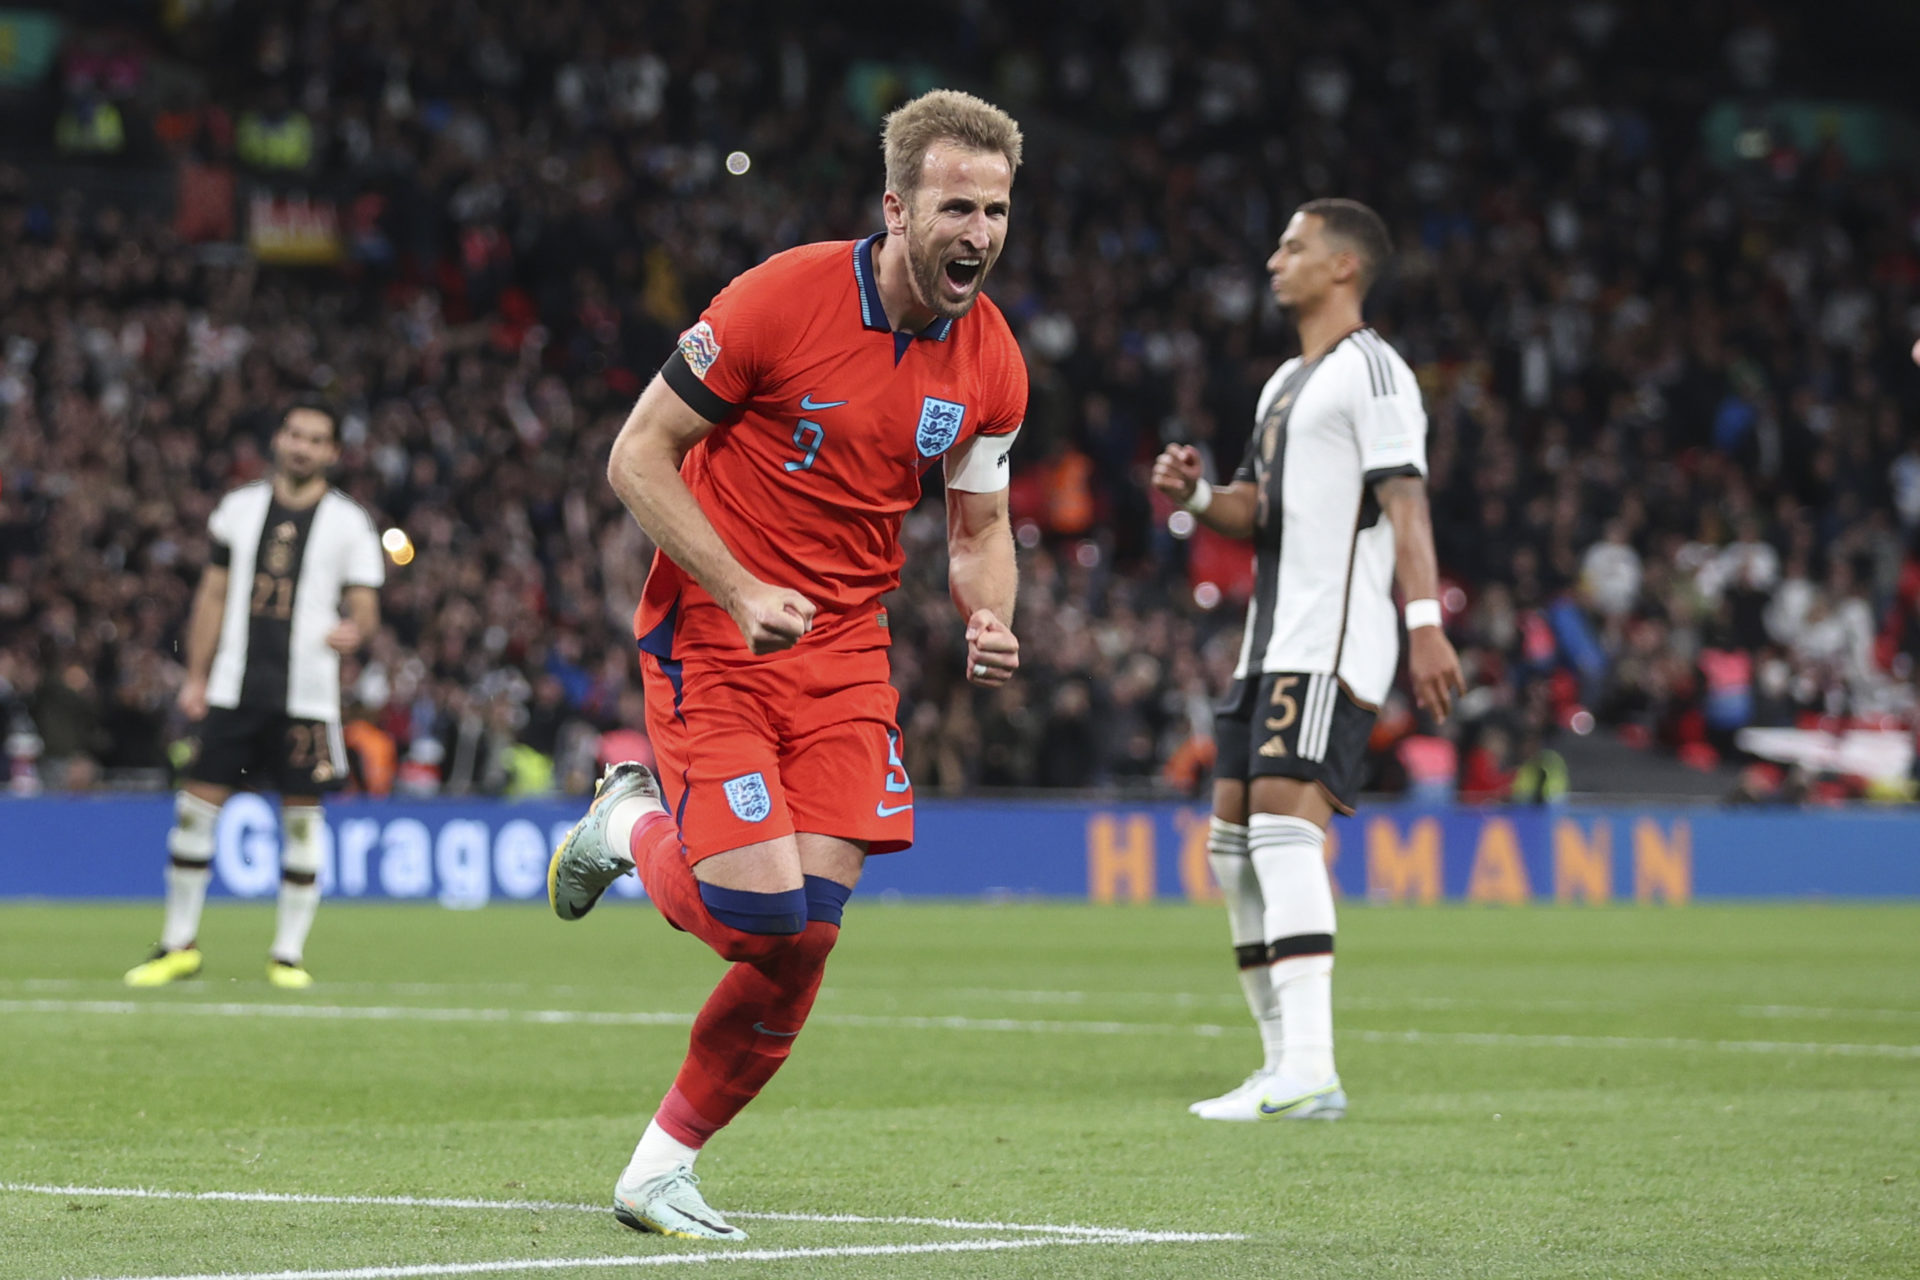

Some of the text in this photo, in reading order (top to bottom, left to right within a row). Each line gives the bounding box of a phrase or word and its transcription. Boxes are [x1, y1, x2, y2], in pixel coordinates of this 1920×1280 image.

[784, 418, 825, 472] 9
[252, 573, 293, 620] 21
[1265, 676, 1300, 731] 5
[1088, 810, 1695, 905] HMANN
